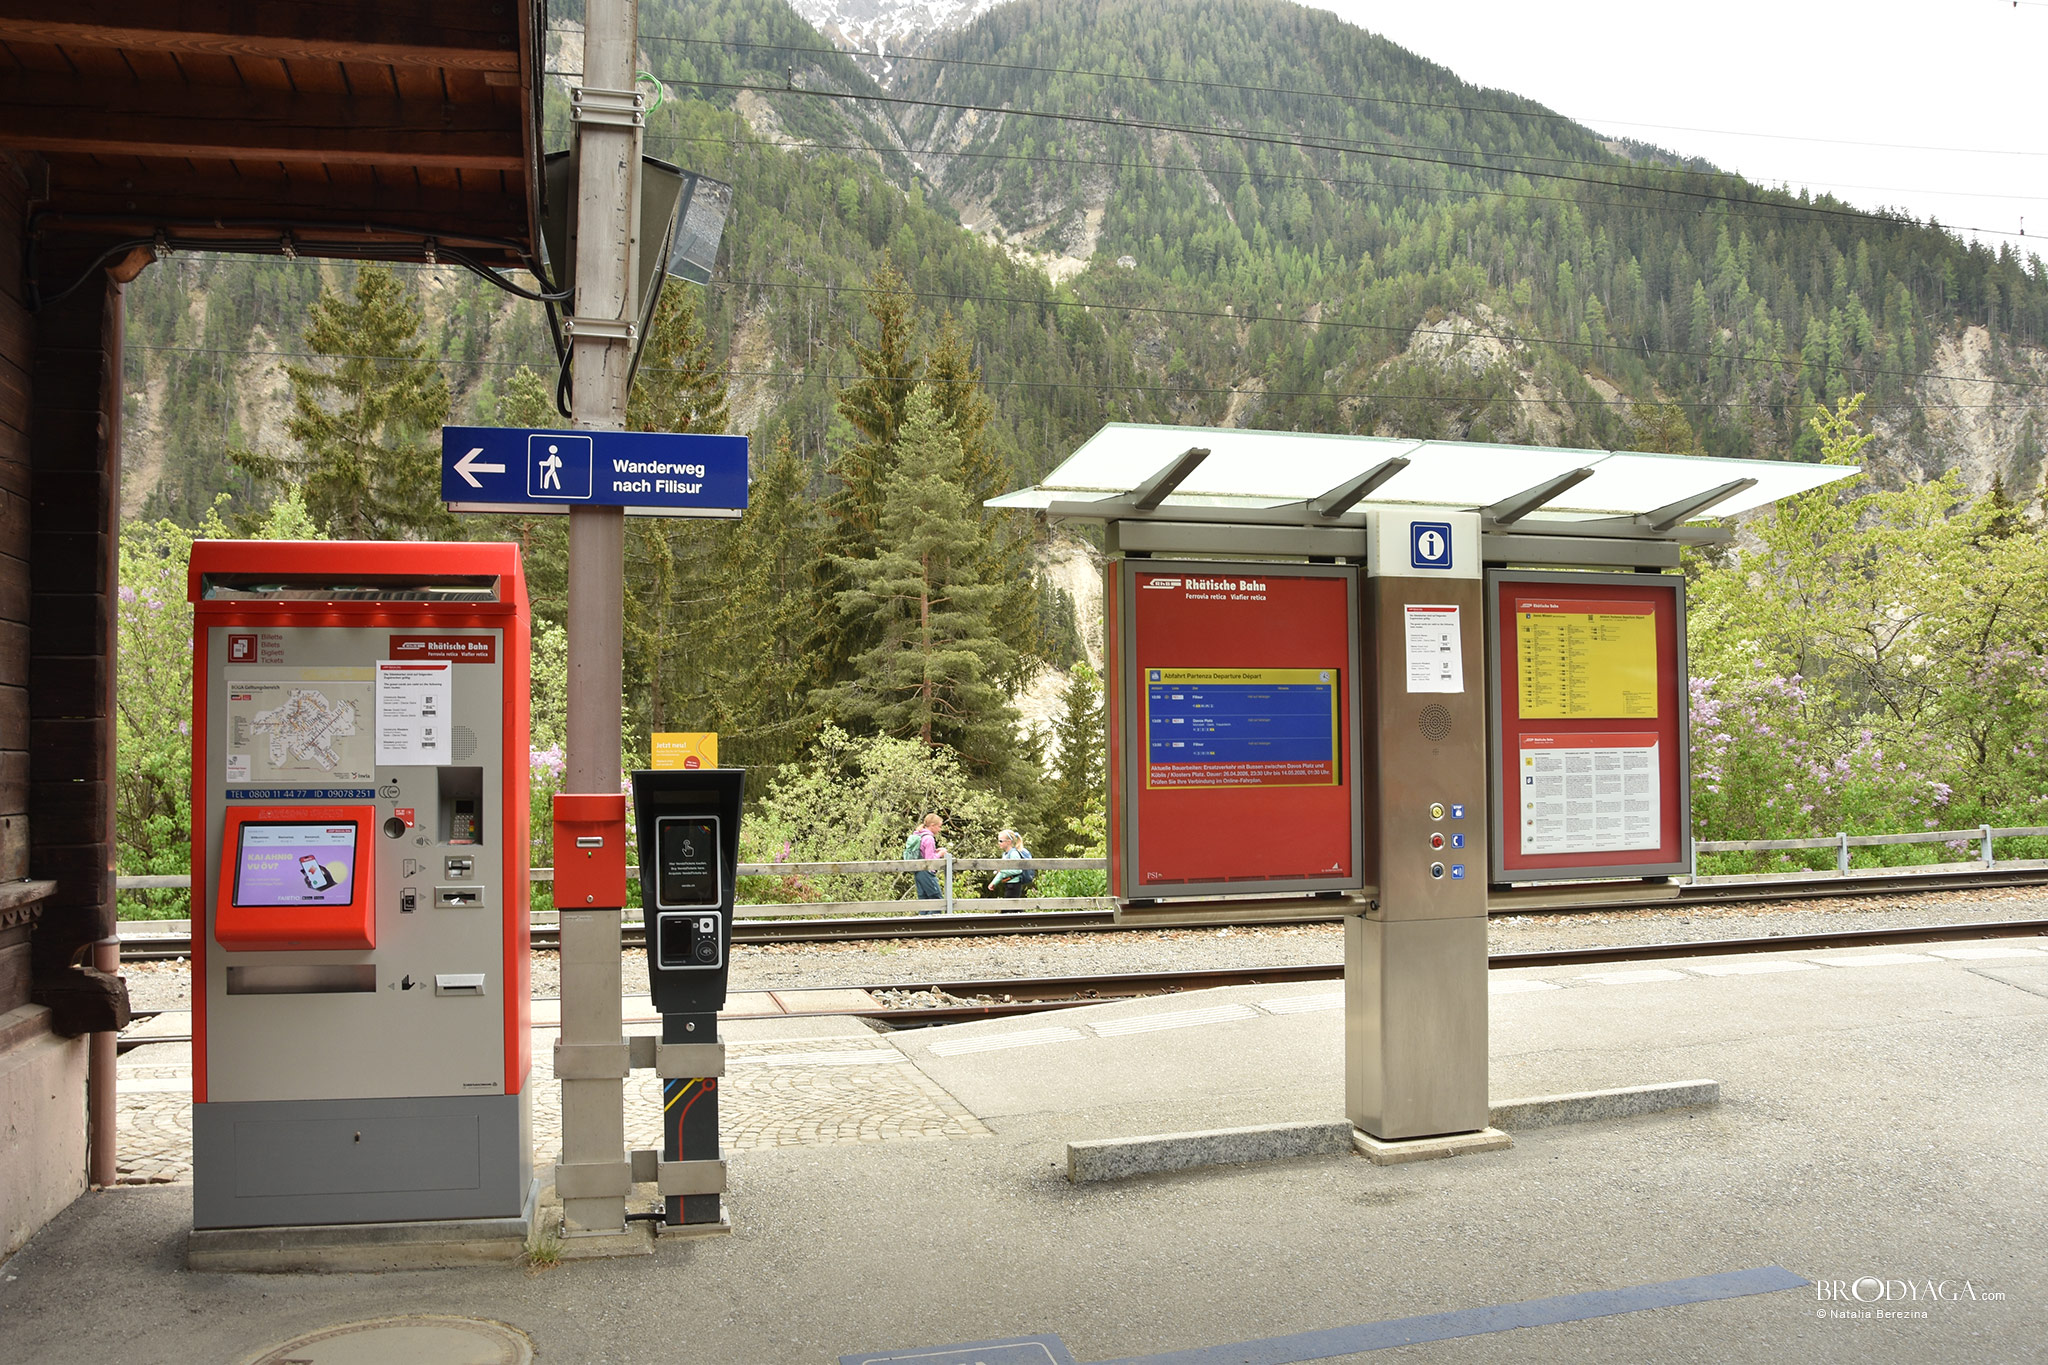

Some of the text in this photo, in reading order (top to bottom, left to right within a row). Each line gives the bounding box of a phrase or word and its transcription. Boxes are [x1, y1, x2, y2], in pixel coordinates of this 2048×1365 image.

[613, 459, 705, 478] Wanderweg
[613, 479, 703, 494] nach Filisur
[1185, 579, 1266, 591] Rhätische Bahn
